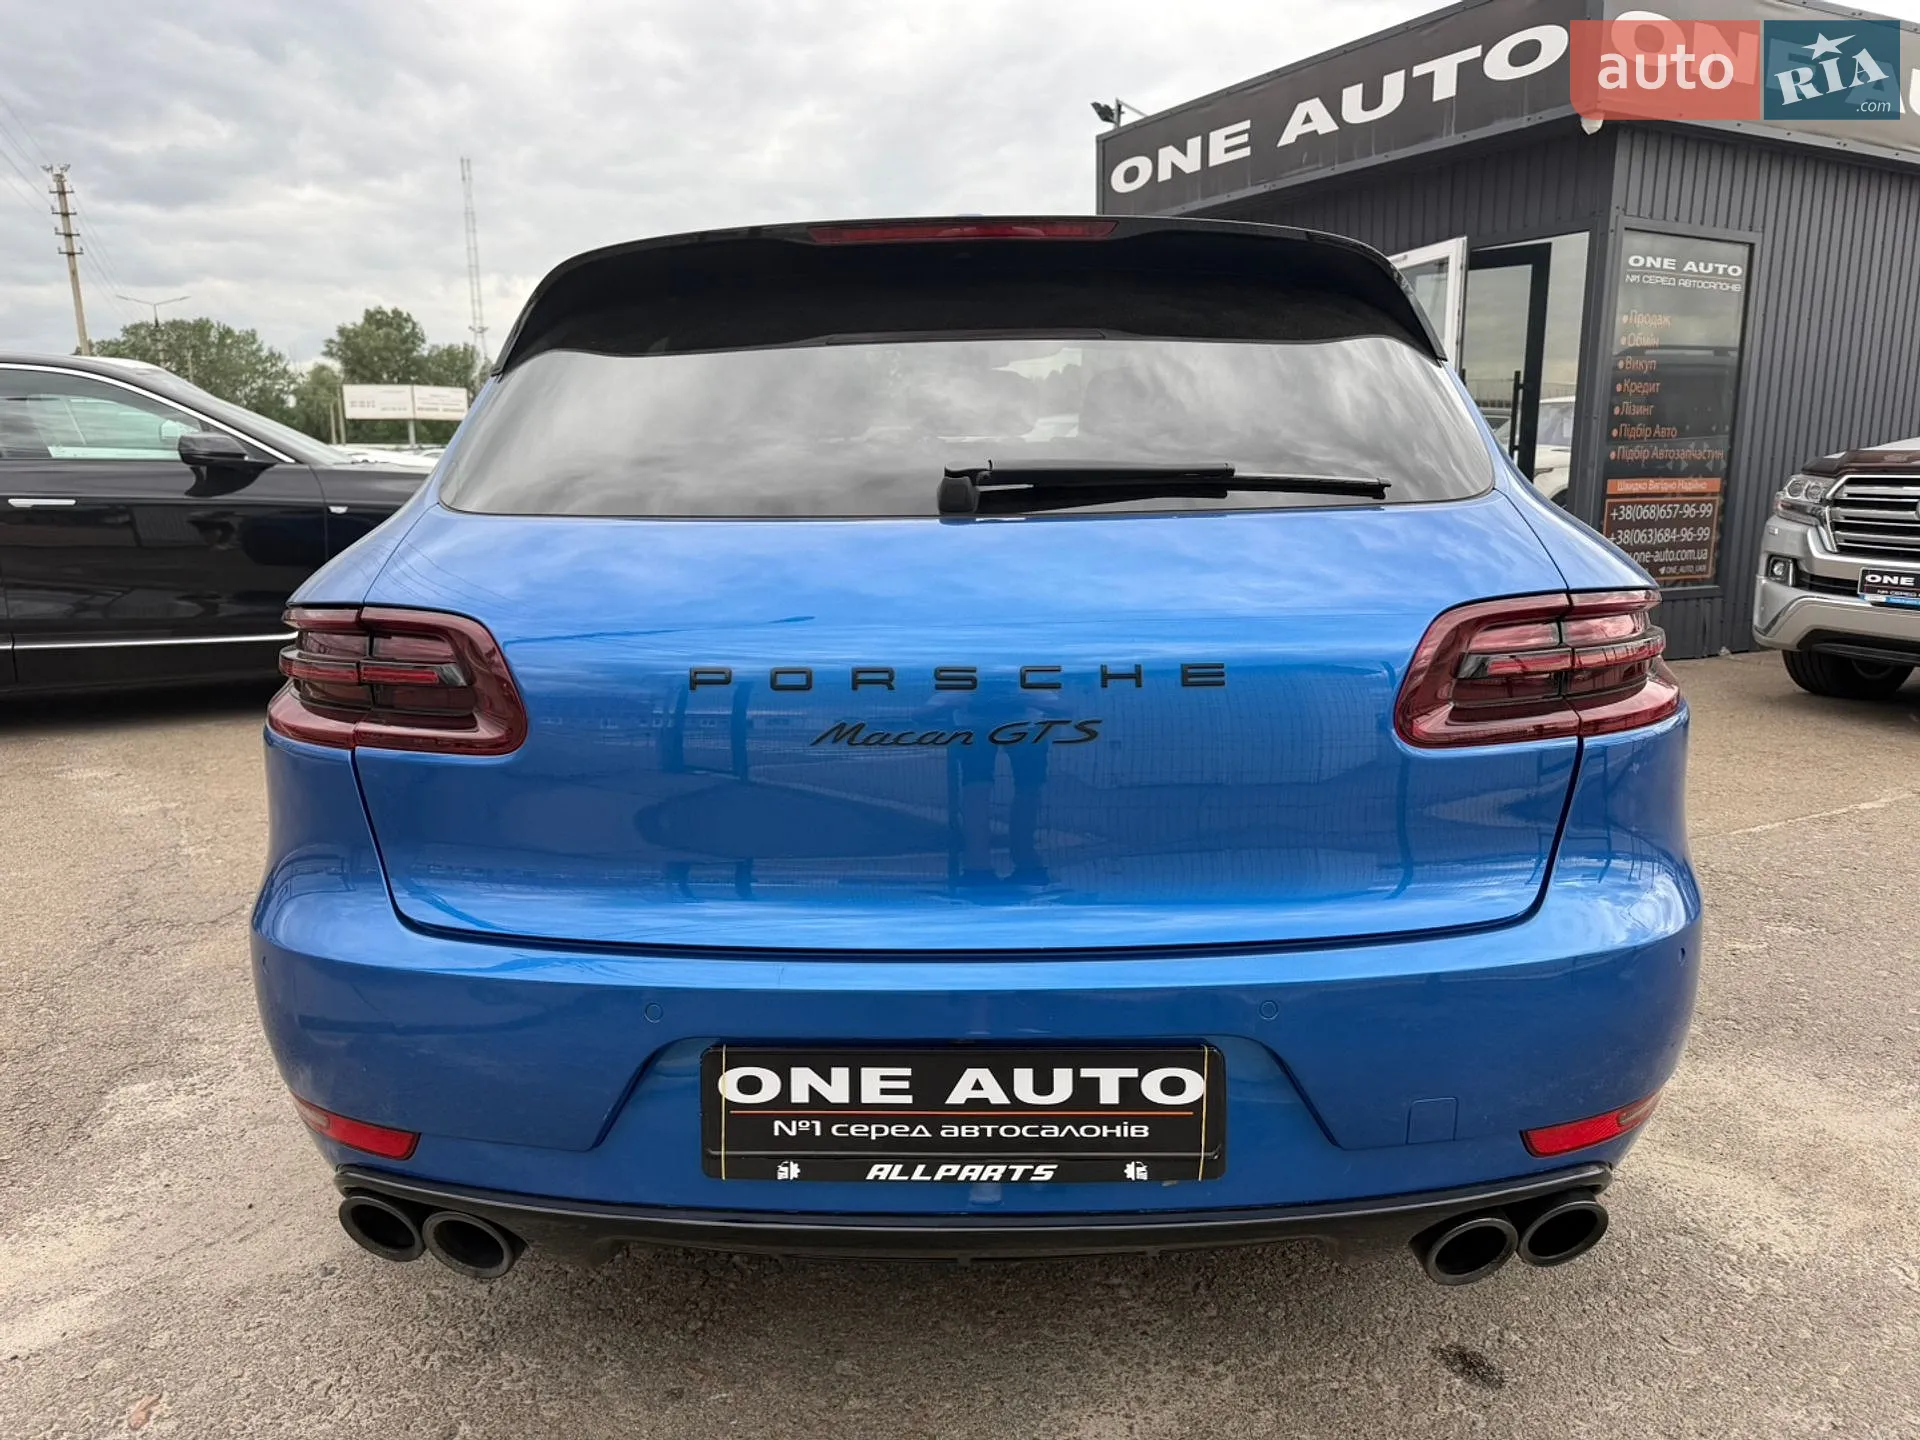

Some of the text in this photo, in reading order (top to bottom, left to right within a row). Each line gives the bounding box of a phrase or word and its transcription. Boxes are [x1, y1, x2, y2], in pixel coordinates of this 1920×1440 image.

[1110, 24, 1570, 194] ONE AUTO
[1628, 255, 1743, 276] ONE AUTO
[1629, 310, 1671, 328] Продаж
[1625, 356, 1657, 374] Викуп
[1623, 379, 1661, 395] Кредит
[1619, 424, 1678, 440] Підбір Авто
[1610, 503, 1713, 521] +38(068)657-96-99
[1865, 574, 1915, 586] ONE
[689, 662, 1226, 691] PORSCHE
[810, 718, 1103, 748] Macan GTS
[718, 1066, 1205, 1105] ONE AUTO
[831, 1121, 932, 1141] серед
[940, 1119, 1150, 1138] автосалонів
[866, 1163, 1058, 1182] ALLPARTS
